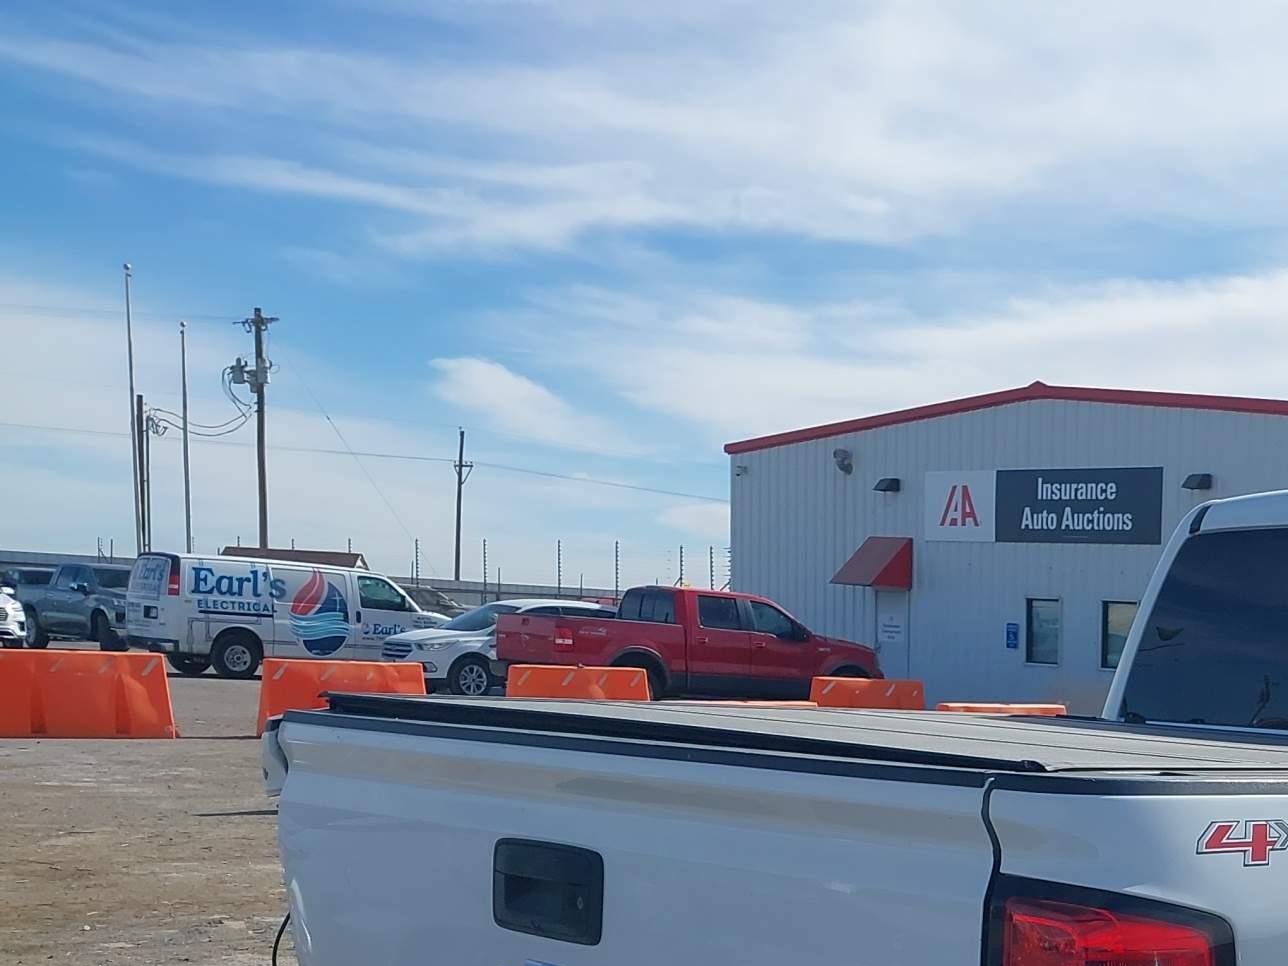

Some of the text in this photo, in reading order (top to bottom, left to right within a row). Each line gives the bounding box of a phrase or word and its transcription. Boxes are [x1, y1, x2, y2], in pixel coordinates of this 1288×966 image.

[1037, 477, 1117, 500] Insurance
[1020, 506, 1133, 531] Auto Auctions
[191, 566, 287, 599] Earl's
[197, 599, 277, 613] ELECTRICAL
